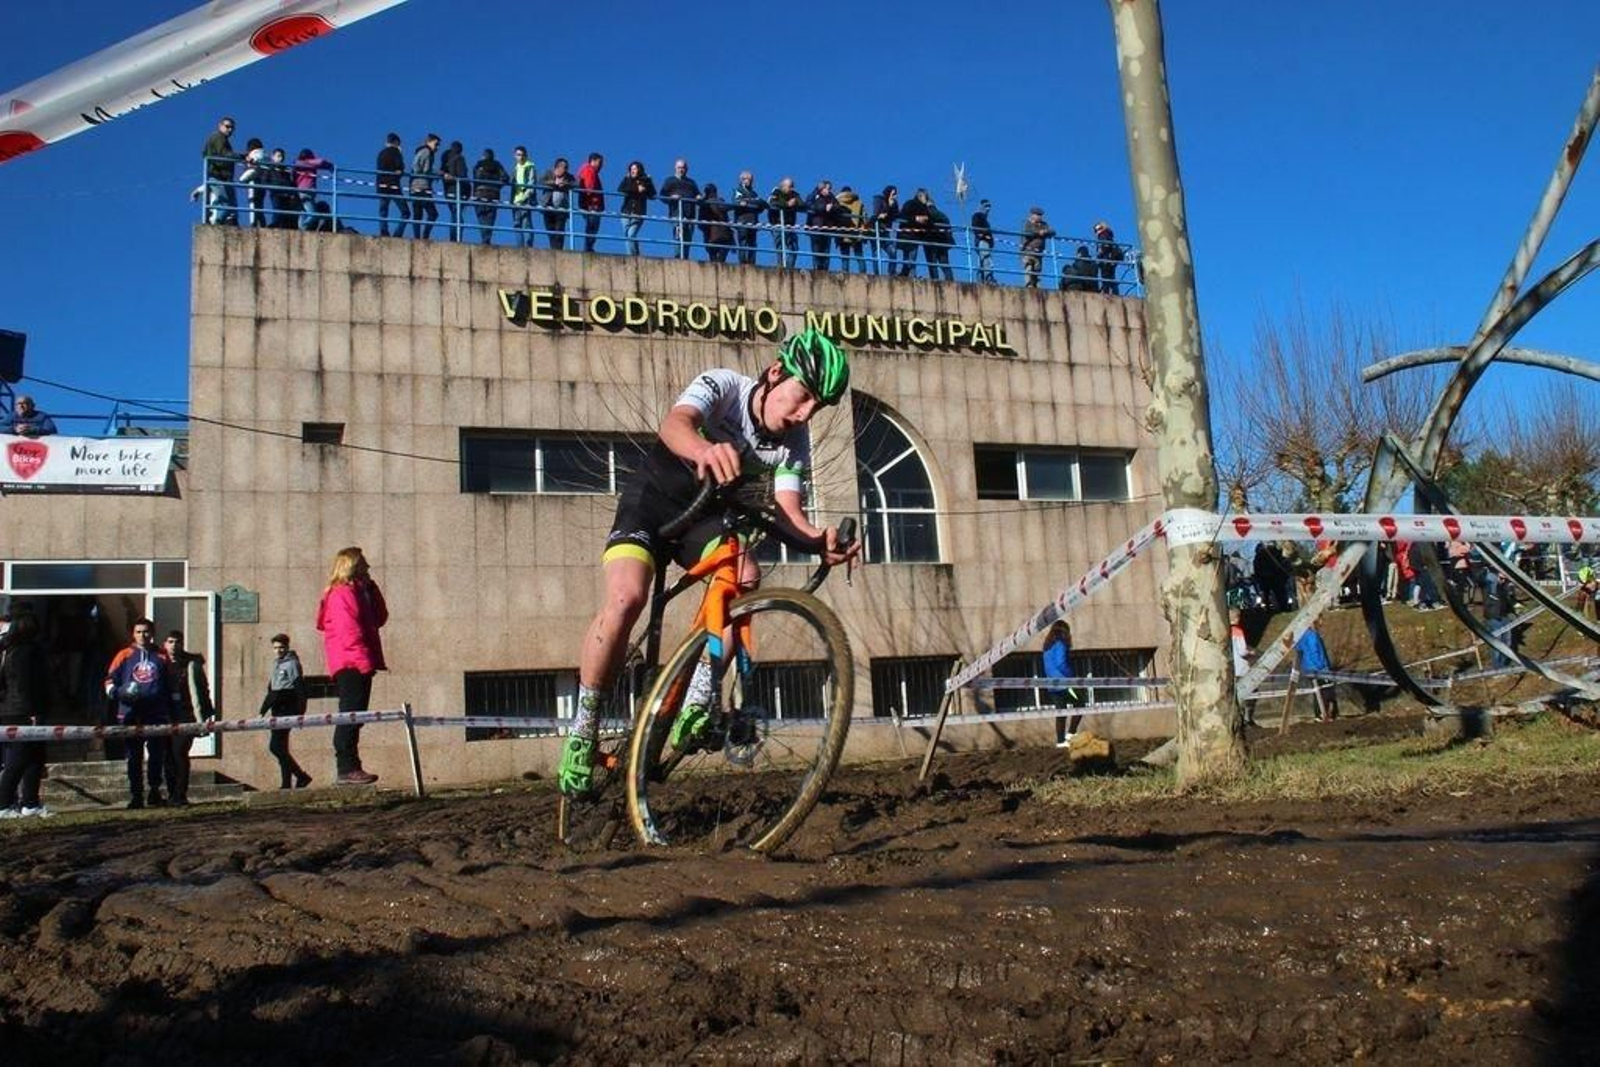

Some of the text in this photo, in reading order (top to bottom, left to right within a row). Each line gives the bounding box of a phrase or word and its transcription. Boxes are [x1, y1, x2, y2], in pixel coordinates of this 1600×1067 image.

[499, 290, 1012, 348] VELODROMO MUNICIPAL
[71, 446, 152, 461] More bike
[75, 463, 148, 476] more life
